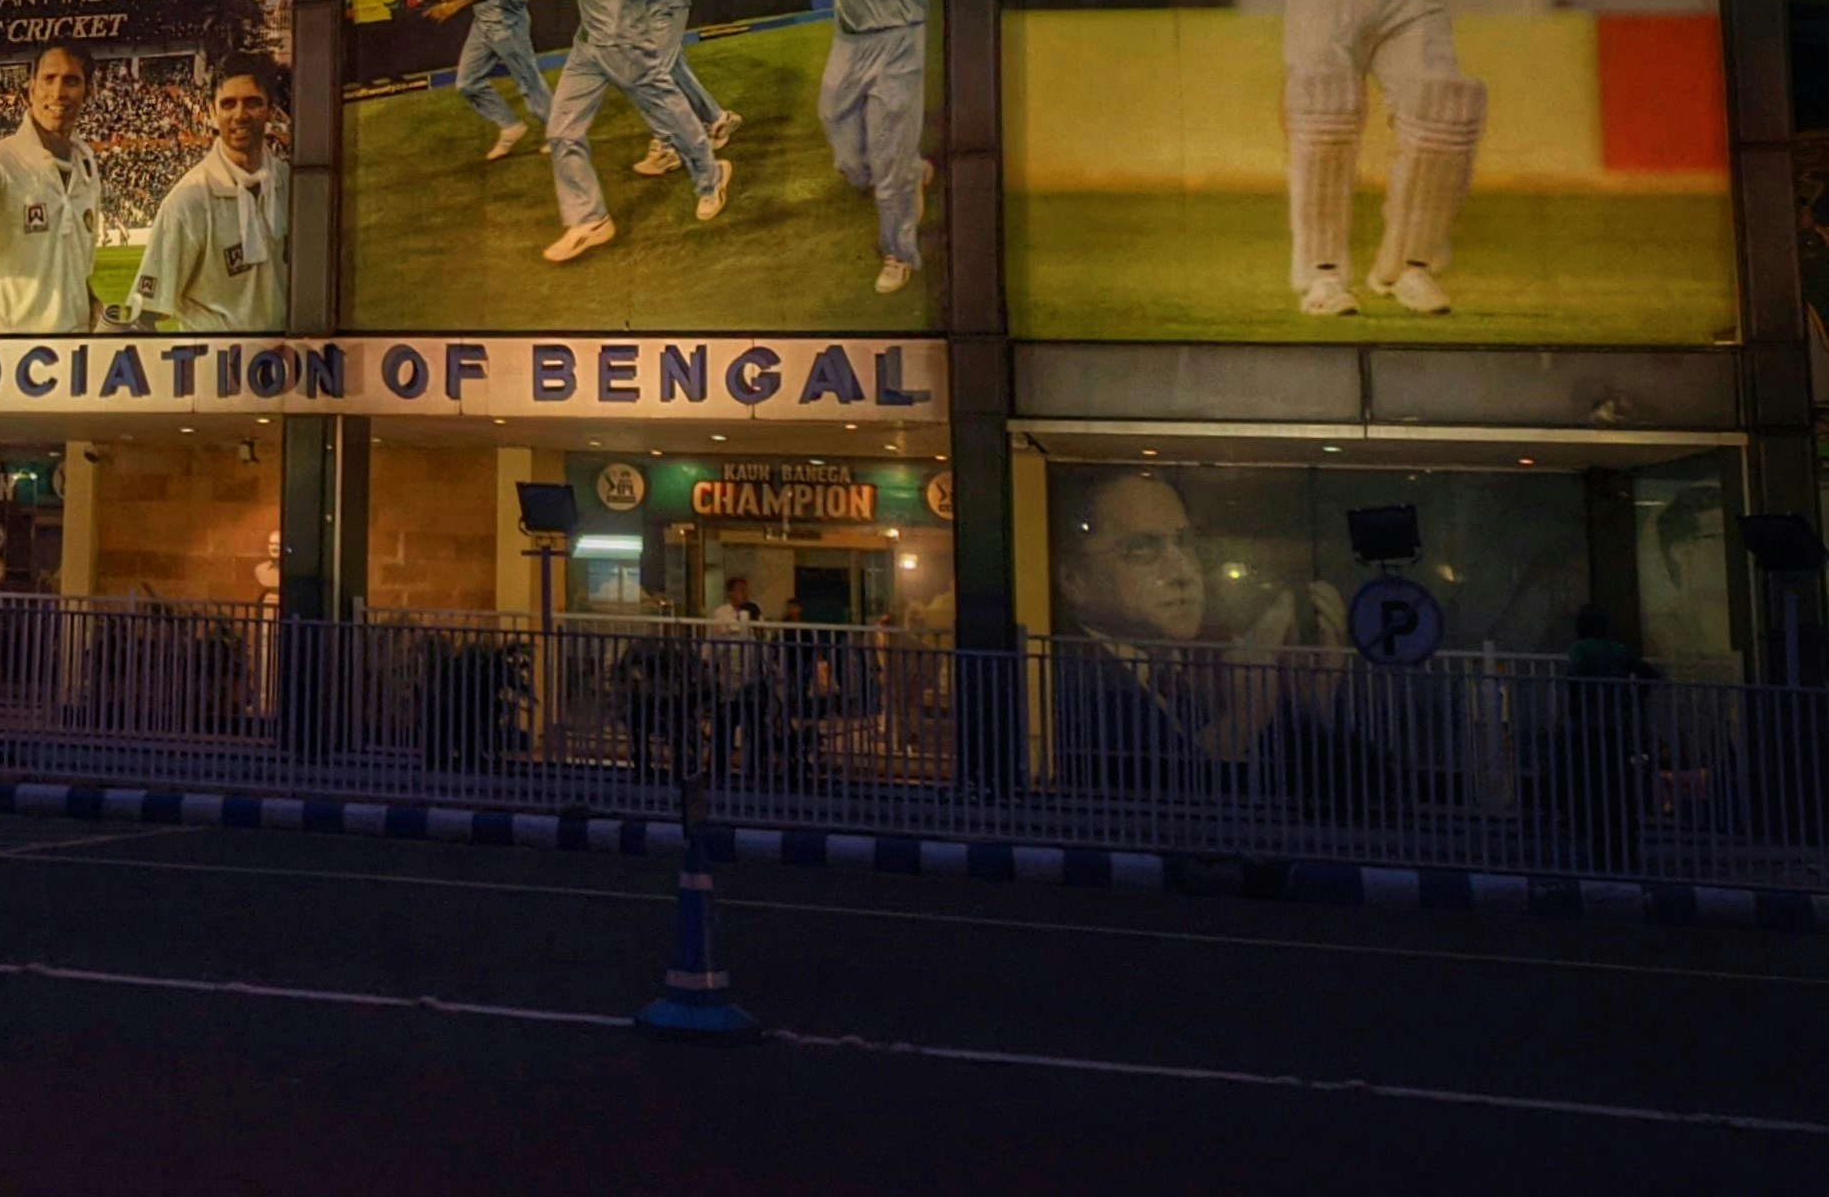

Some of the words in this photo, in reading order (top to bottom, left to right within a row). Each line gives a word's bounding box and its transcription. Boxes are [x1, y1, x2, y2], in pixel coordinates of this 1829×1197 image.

[6, 12, 129, 44] CRICKET
[382, 344, 488, 399] OF
[532, 344, 931, 405] BENGAL
[723, 463, 771, 481] KAUN
[781, 464, 853, 484] BANEGA
[692, 480, 877, 521] CHAMPION
[1381, 600, 1418, 656] P
